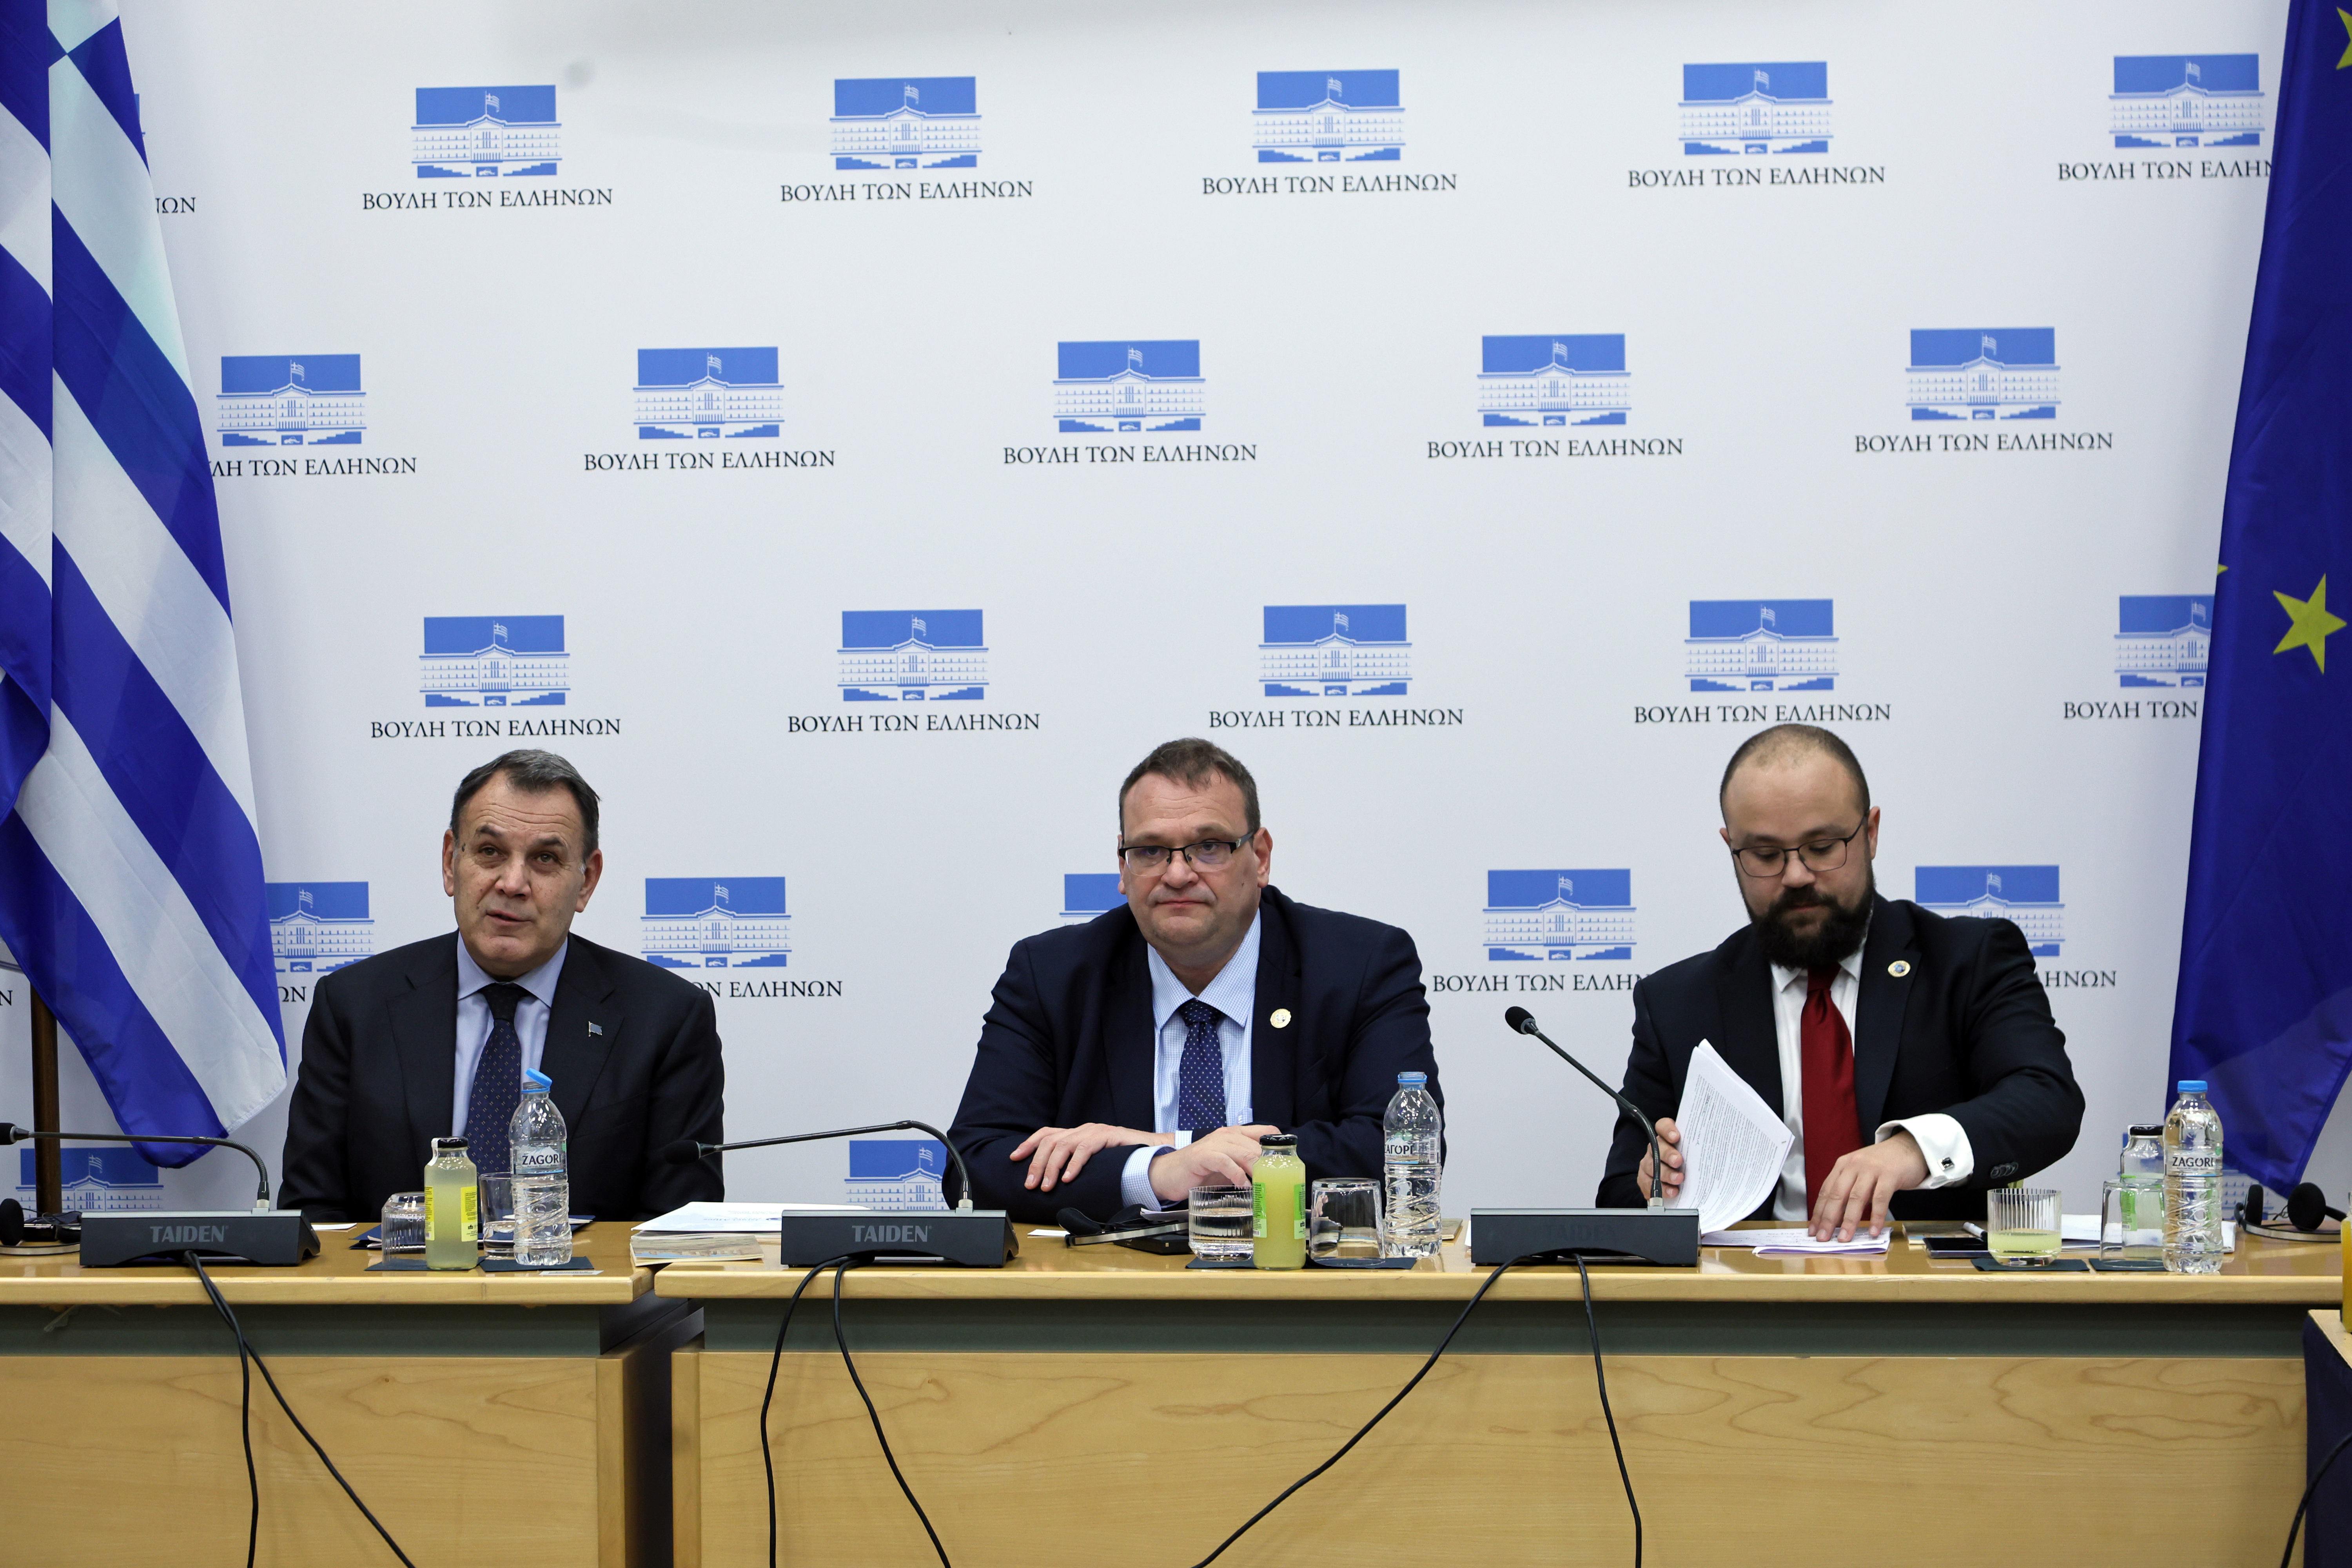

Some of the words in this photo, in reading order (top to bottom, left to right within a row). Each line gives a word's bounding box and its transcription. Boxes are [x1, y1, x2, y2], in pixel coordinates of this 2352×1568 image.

[1629, 170, 1705, 187] ΒΟΥΛΗ
[1710, 169, 1760, 186] ΤΩΝ
[1768, 167, 1884, 185] ΕΛΛΗΝΩΝ
[2058, 163, 2135, 180] ΒΟΥΛΗ
[2142, 162, 2192, 179] ΤΩΝ
[781, 185, 855, 201] ΒΟΥΛΗ
[862, 183, 911, 200] ΤΩΝ
[920, 181, 1032, 199] ΕΛΛΗΝΩΝ
[1203, 178, 1278, 194] ΒΟΥΛΗ
[1283, 177, 1333, 193] ΤΩΝ
[1341, 174, 1456, 192] ΕΛΛΗΝΩΝ
[363, 193, 437, 210] ΒΟΥΛΗ
[443, 191, 492, 208] ΤΩΝ
[500, 189, 612, 207] ΕΛΛΗΝΩΝ
[1428, 441, 1503, 458] ΒΟΥΛΗ
[1510, 441, 1559, 457] ΤΩΝ
[1567, 439, 1682, 456] ΕΛΛΗΝΩΝ
[1856, 436, 1932, 452] ΒΟΥΛΗ
[1938, 435, 1988, 451] ΤΩΝ
[1996, 433, 2112, 450] ΕΛΛΗΝΩΝ
[584, 454, 659, 470] ΒΟΥΛΗ
[665, 453, 714, 469] ΤΩΝ
[722, 451, 835, 468] ΕΛΛΗΝΩΝ
[1004, 447, 1079, 464] ΒΟΥΛΗ
[1085, 446, 1134, 463] ΤΩΝ
[1143, 445, 1256, 462] ΕΛΛΗΝΩΝ
[248, 460, 297, 476] ΤΩΝ
[305, 458, 416, 475] ΕΛΛΗΝΩΝ
[1209, 711, 1284, 728] ΒΟΥΛΗ
[1291, 710, 1340, 726] ΤΩΝ
[1349, 709, 1463, 726] ΕΛΛΗΝΩΝ
[1635, 706, 1710, 723] ΒΟΥΛΗ
[1717, 706, 1767, 722] ΤΩΝ
[1775, 704, 1890, 722] ΕΛΛΗΝΩΝ
[2063, 702, 2140, 719] ΒΟΥΛΗ
[2147, 701, 2198, 718] ΤΩΝ
[370, 721, 445, 738] ΒΟΥΛΗ
[451, 720, 501, 737] ΤΩΝ
[508, 719, 621, 736] ΕΛΛΗΝΩΝ
[788, 716, 863, 732] ΒΟΥΛΗ
[869, 715, 918, 731] ΤΩΝ
[927, 714, 1040, 731] ΕΛΛΗΝΩΝ
[1433, 976, 1509, 992] ΒΟΥΛΗ
[1515, 975, 1564, 991] ΤΩΝ
[2034, 970, 2117, 987] ΗΝΩΝ
[729, 981, 843, 997] ΕΛΛΗΝΩΝ
[522, 1154, 561, 1165] ZAGORI
[2172, 1156, 2213, 1167] ZAGORI
